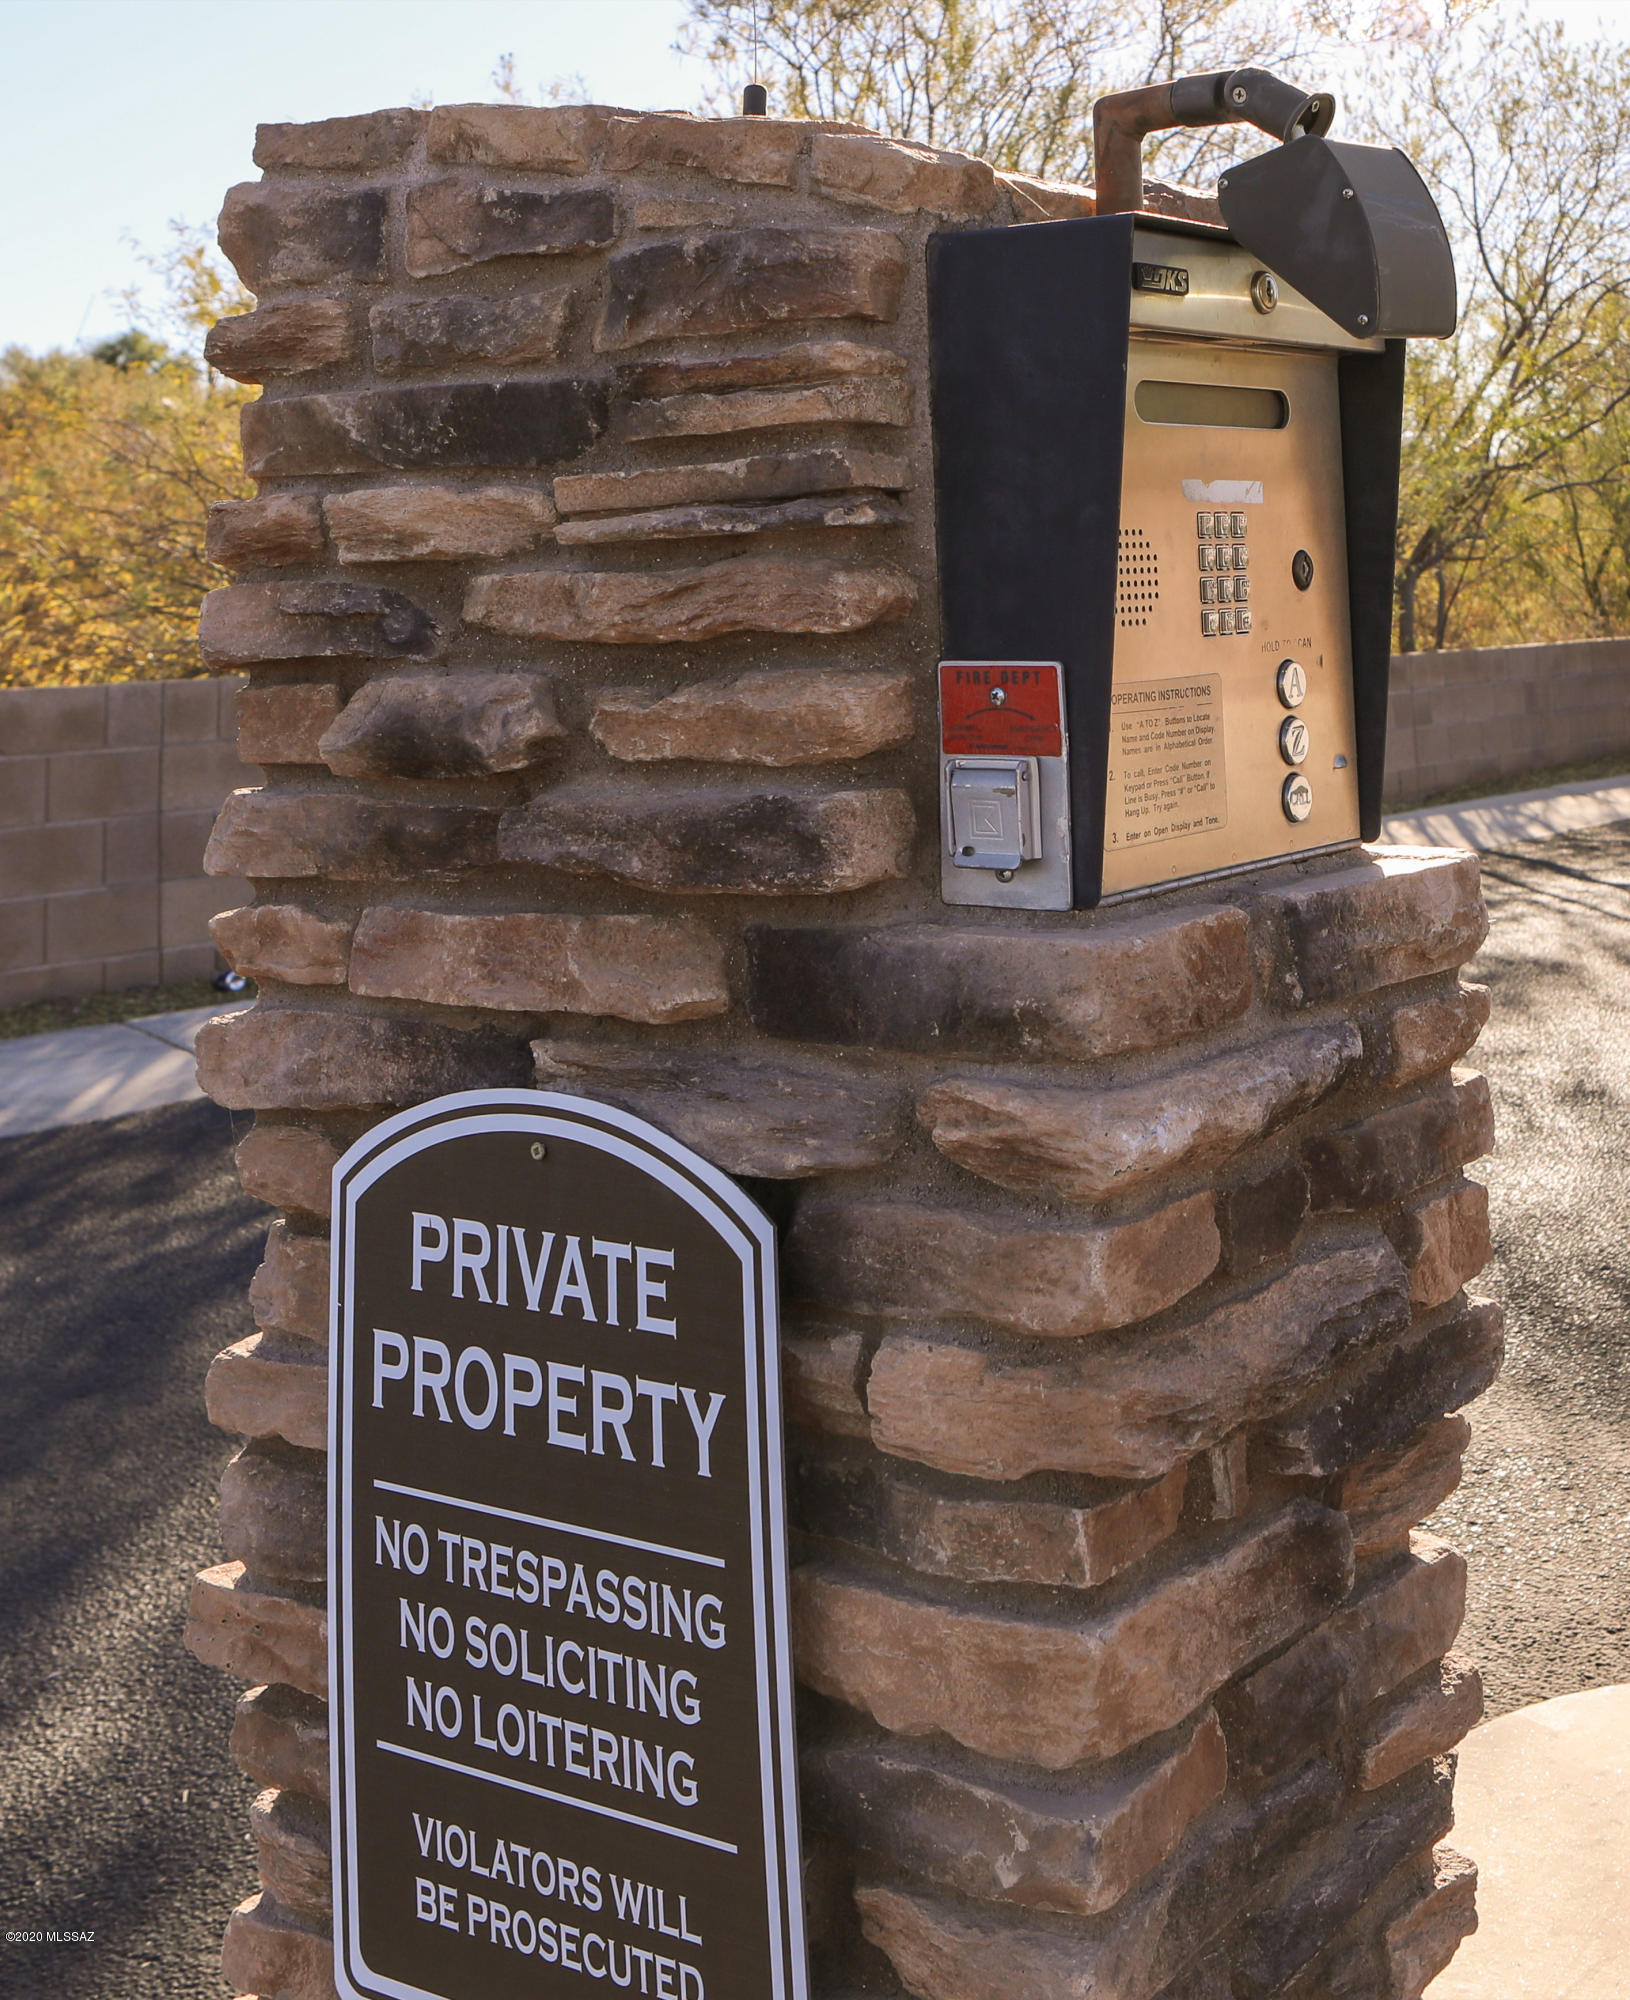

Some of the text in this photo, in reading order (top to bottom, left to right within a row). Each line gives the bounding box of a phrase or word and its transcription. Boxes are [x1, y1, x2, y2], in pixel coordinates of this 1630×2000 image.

[1261, 640, 1280, 652] HOLD
[1293, 637, 1312, 648] CAN
[956, 671, 1040, 684] FIRE DEPT
[1289, 667, 1303, 698] A
[1112, 685, 1212, 705] OPERATING INSTRUCTIONS
[1164, 716, 1186, 725] Buttons
[1193, 713, 1210, 722] Locate
[1122, 735, 1138, 743] Name
[1138, 733, 1150, 741] and
[1150, 732, 1165, 741] Code
[1165, 729, 1187, 738] Number
[1122, 747, 1142, 756] Names
[1143, 745, 1154, 753] are
[1155, 743, 1162, 751] in
[1164, 739, 1197, 751] Alphabetical
[1292, 724, 1305, 756] Z
[1124, 771, 1131, 779] To
[1147, 767, 1162, 775] Enter
[1164, 764, 1180, 773] Code
[1181, 760, 1202, 770] Number
[1124, 782, 1146, 794] Keypad
[1146, 781, 1152, 789] or
[1153, 779, 1169, 788] Press
[1124, 796, 1137, 805] Line
[1137, 794, 1143, 803] is
[1161, 789, 1176, 799] Press
[1186, 786, 1194, 794] or
[1209, 782, 1216, 790] to
[1125, 808, 1140, 818] Hang
[1153, 803, 1162, 813] Try
[1112, 832, 1119, 843] 3.
[1126, 832, 1141, 841] Enter
[1143, 829, 1151, 838] on
[1153, 826, 1168, 836] Open
[1170, 822, 1191, 832] Display
[1193, 818, 1203, 827] and
[411, 1211, 677, 1340] PRIVATE
[371, 1327, 727, 1478] PROPERTY
[374, 1514, 727, 1649] NO TRESPASSING
[399, 1597, 702, 1726] NO SOLICITING
[405, 1675, 700, 1808] NO LOITERING
[411, 1811, 703, 1946] VIOLATORS WILL
[414, 1876, 706, 2000] BE PROSECUTED
